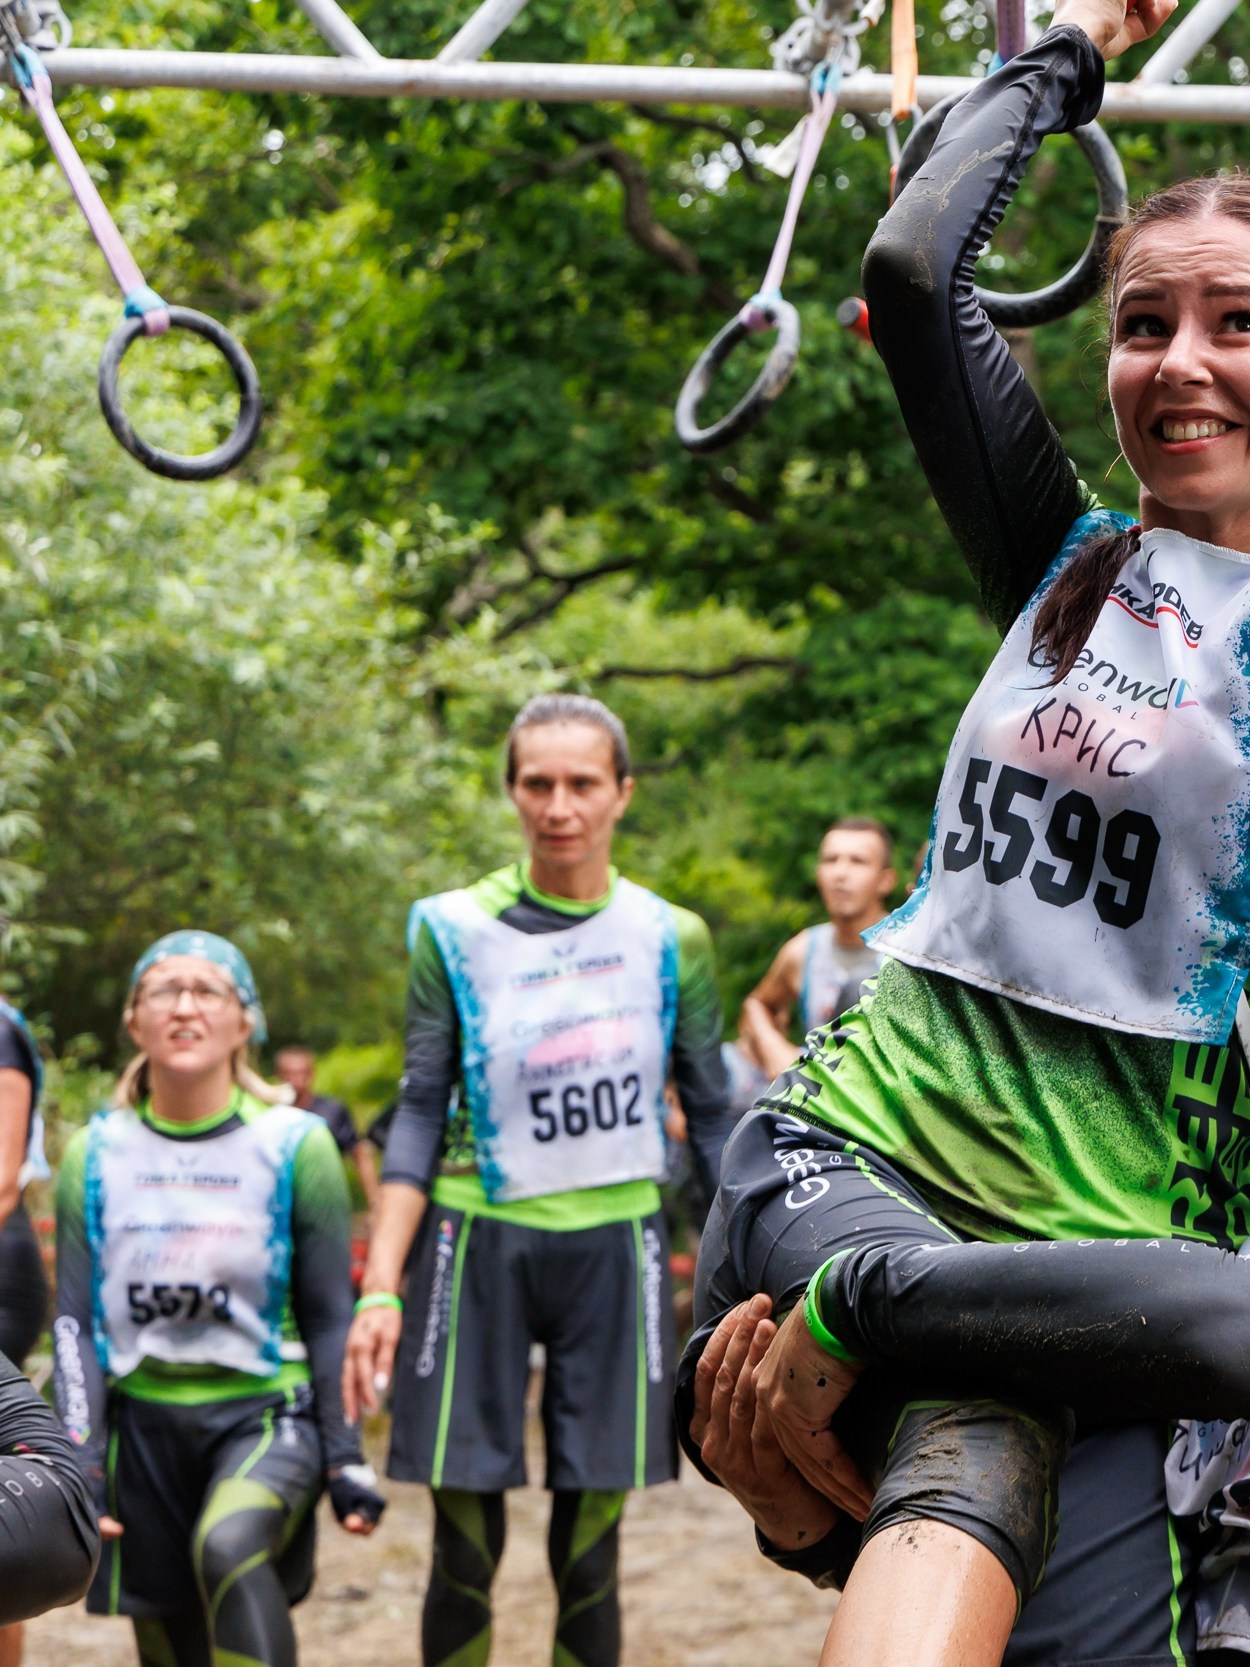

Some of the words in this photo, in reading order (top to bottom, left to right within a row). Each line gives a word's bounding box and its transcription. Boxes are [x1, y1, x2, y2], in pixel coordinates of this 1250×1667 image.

[1021, 697, 1147, 778] КРИС
[943, 758, 1162, 930] 5599
[528, 1073, 643, 1143] 5602
